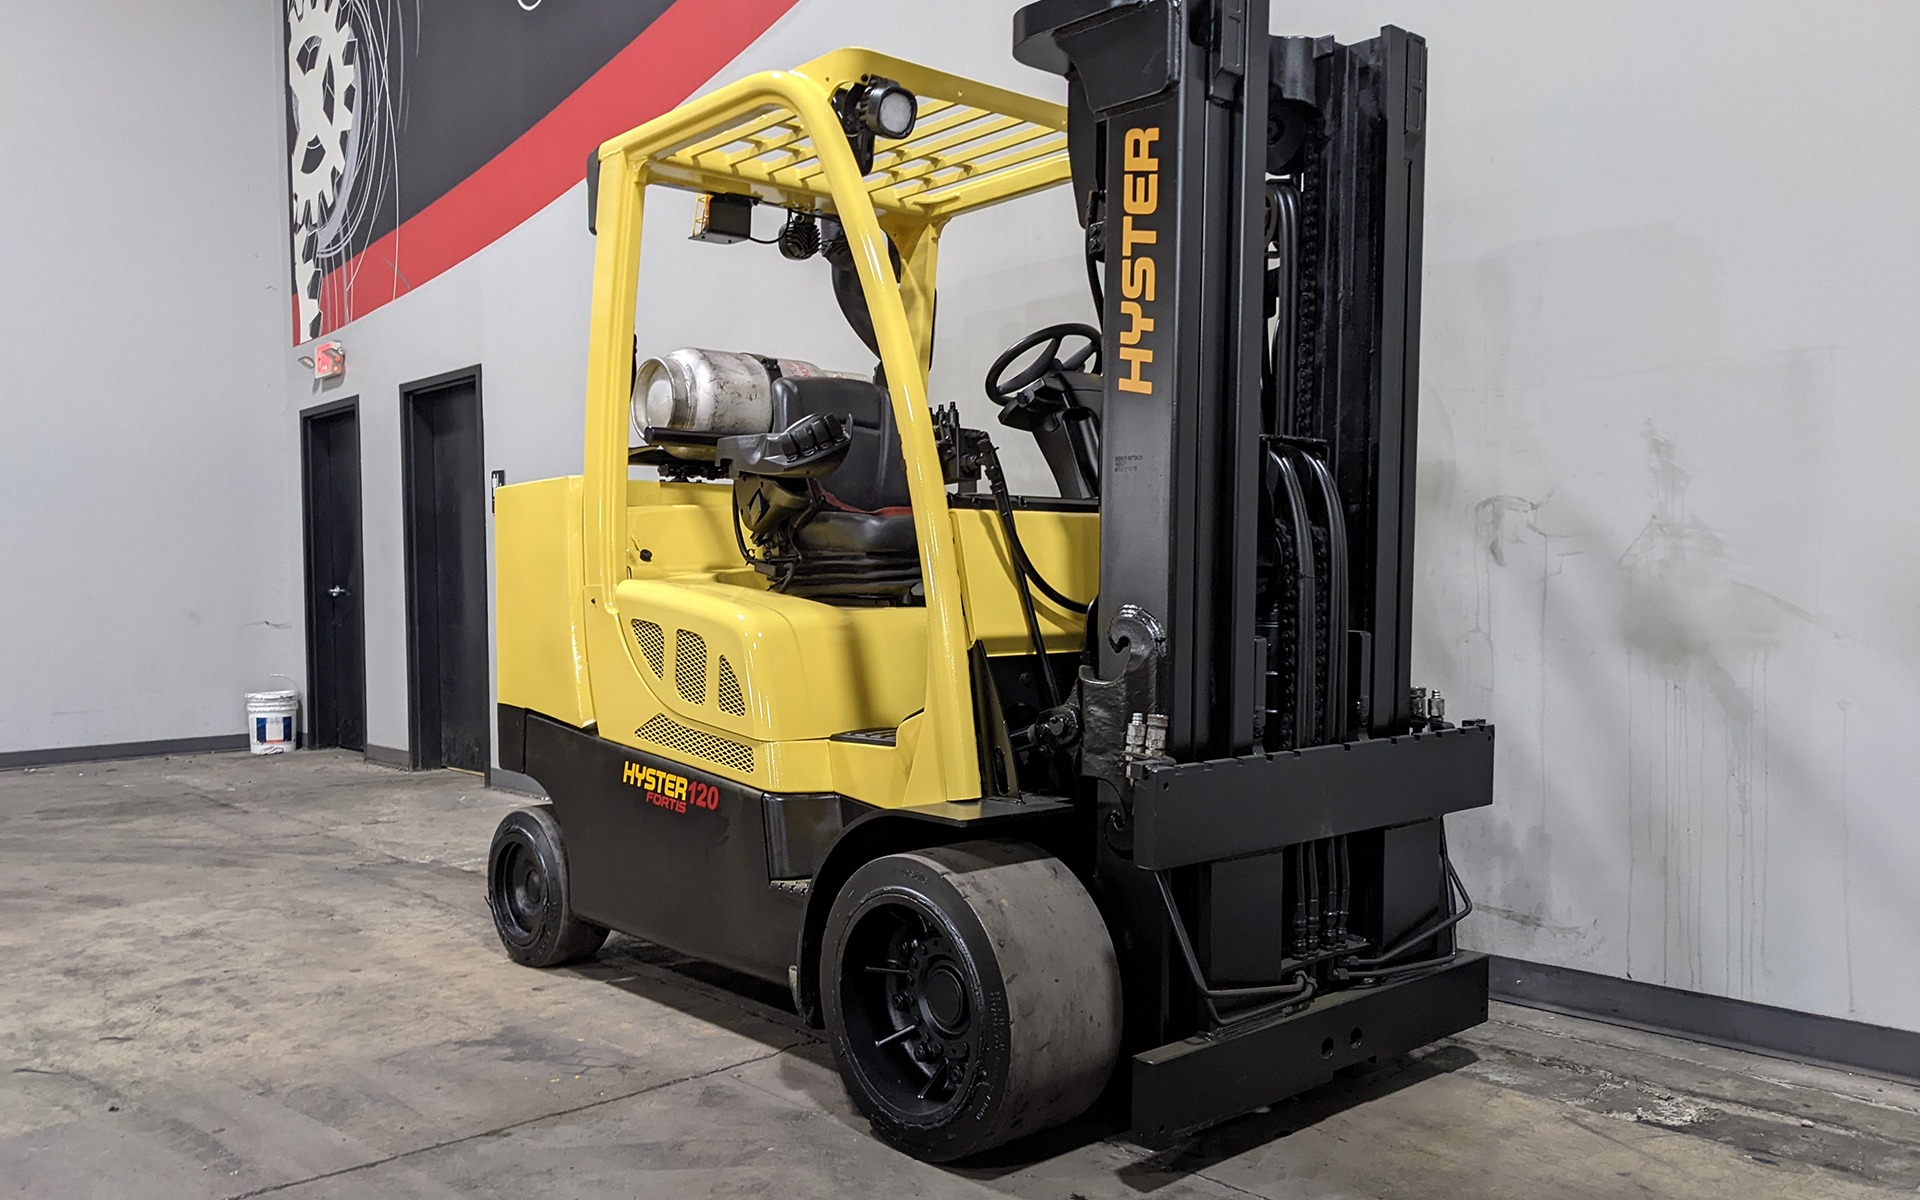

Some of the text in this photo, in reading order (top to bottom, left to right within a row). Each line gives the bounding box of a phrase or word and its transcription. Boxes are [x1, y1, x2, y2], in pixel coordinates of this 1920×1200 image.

[1119, 127, 1160, 395] HYSTER
[622, 761, 719, 810] HYSTER 120
[645, 791, 687, 814] FORTIS
